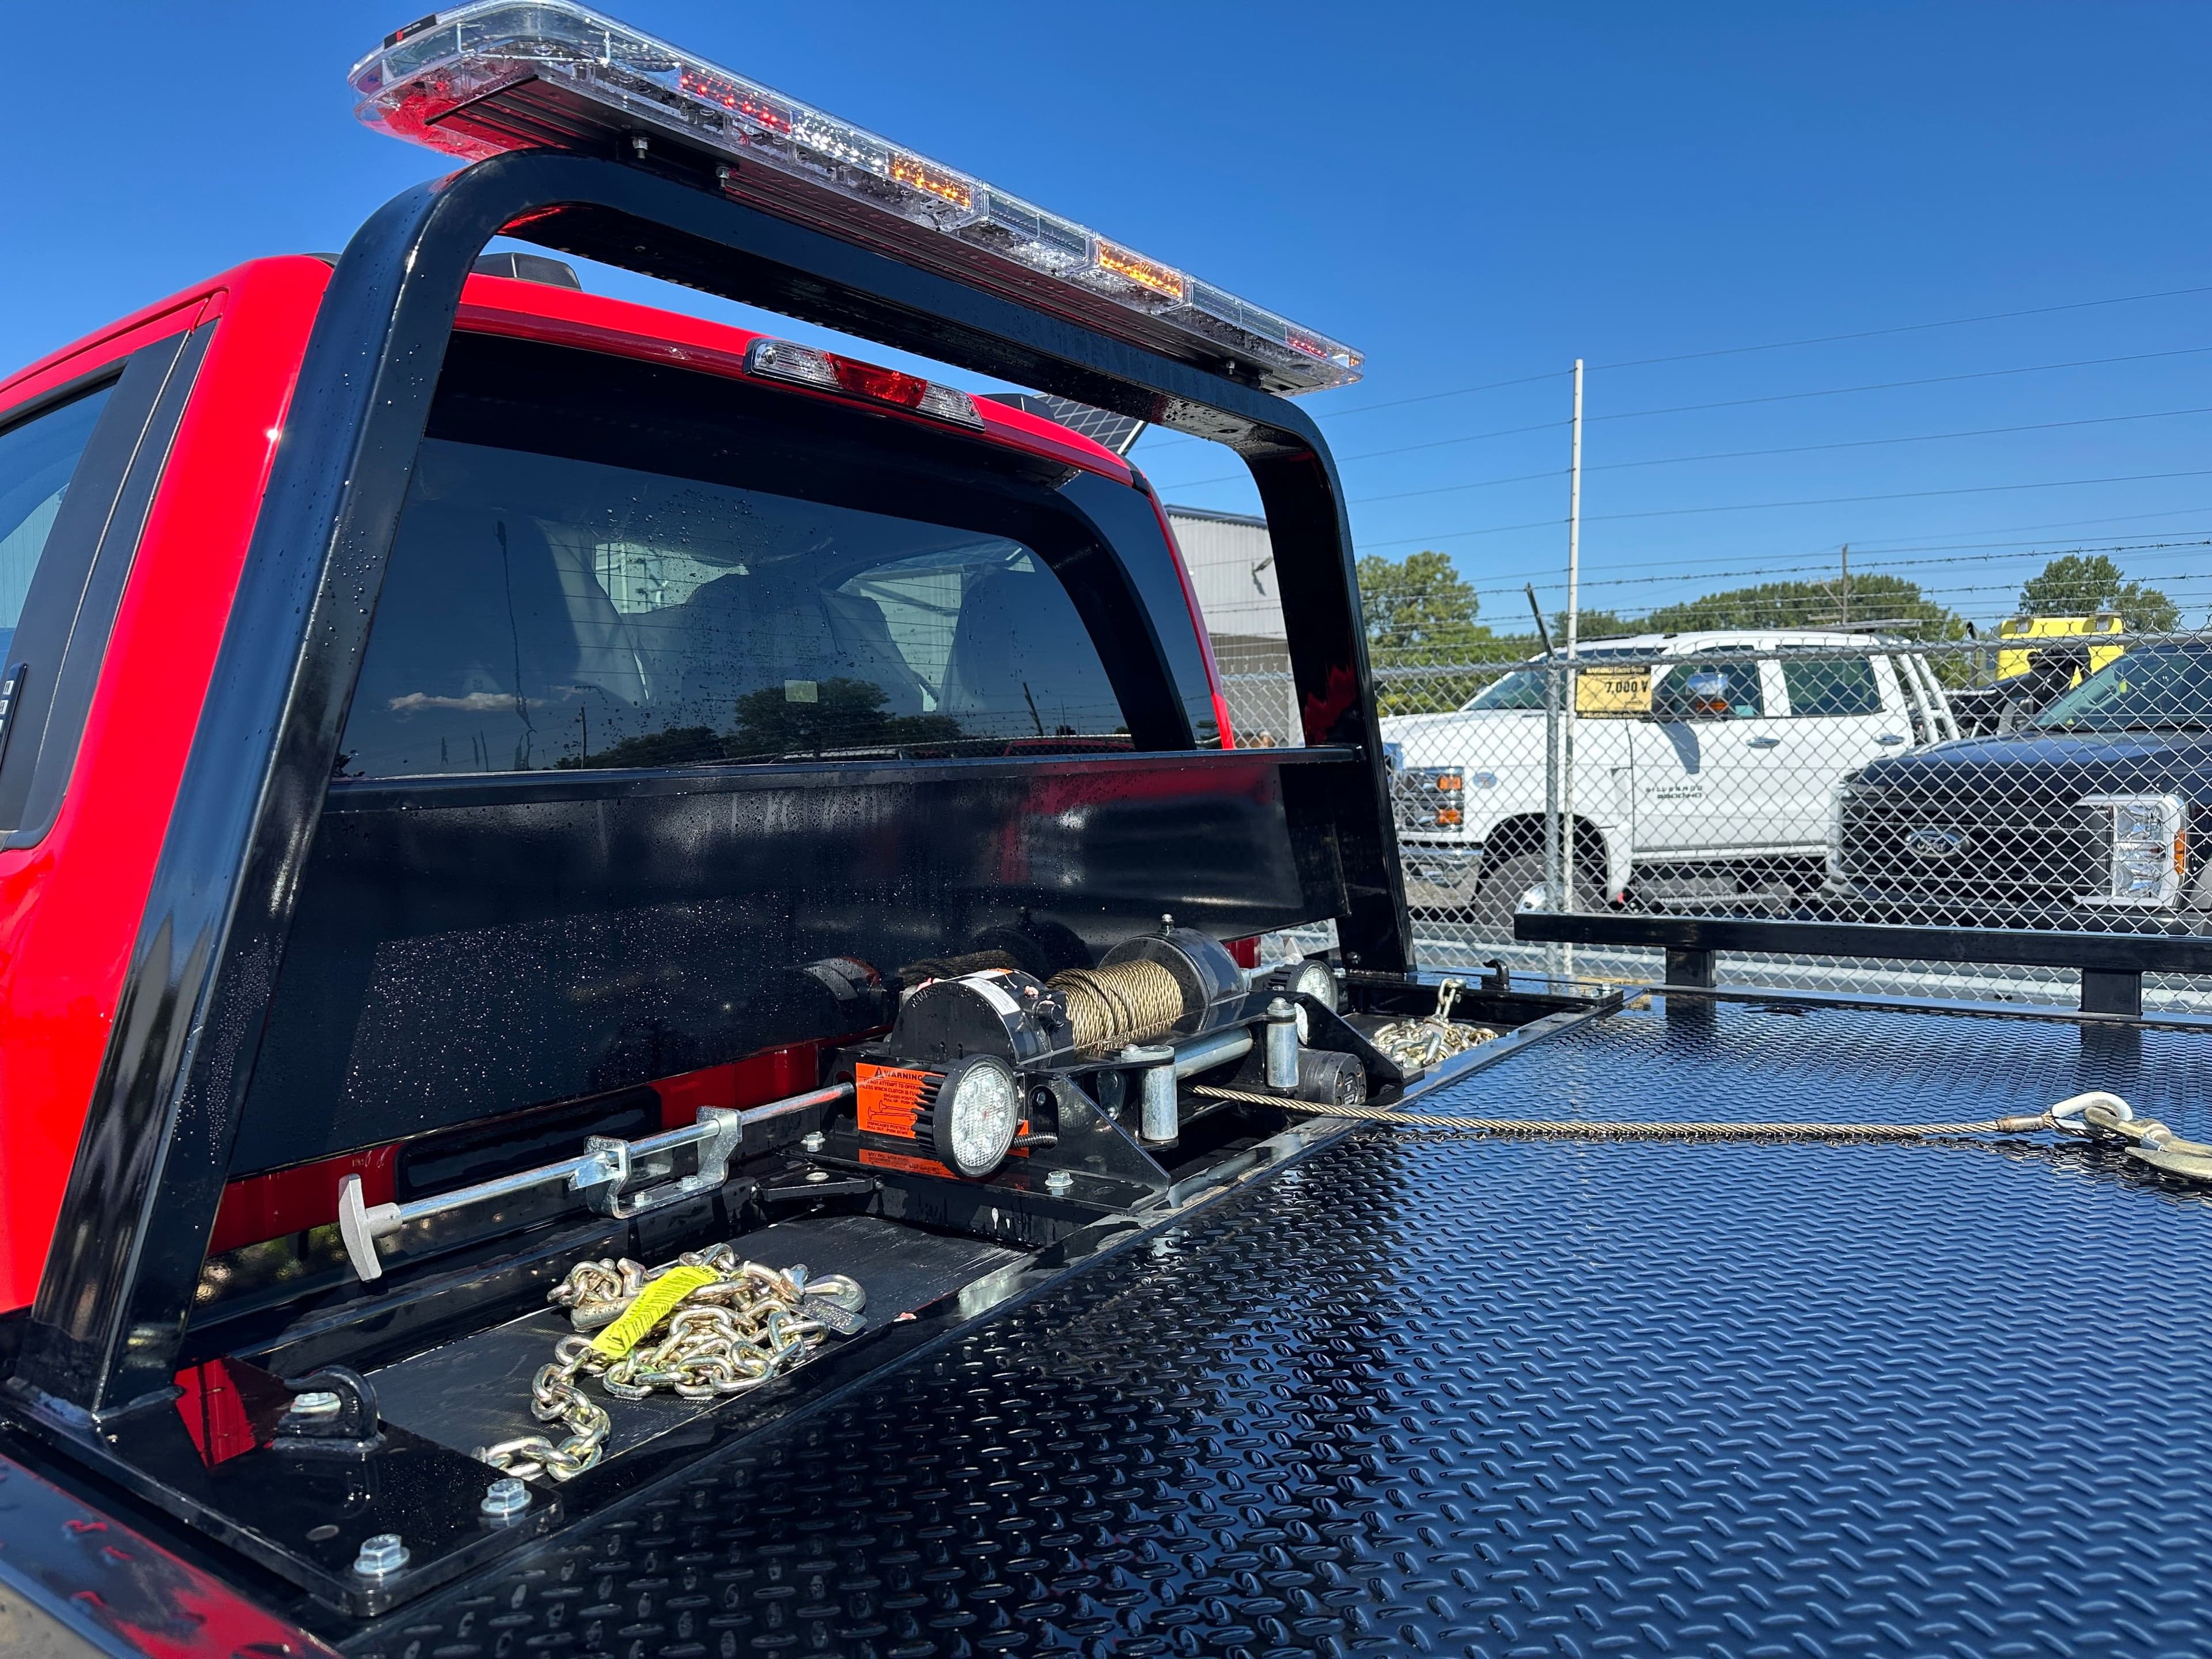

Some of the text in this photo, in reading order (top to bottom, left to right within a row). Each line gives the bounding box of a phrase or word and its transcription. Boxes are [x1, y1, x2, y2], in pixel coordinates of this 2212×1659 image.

[1605, 680, 1648, 695] 7,000 V
[884, 1070, 923, 1081] WARNING
